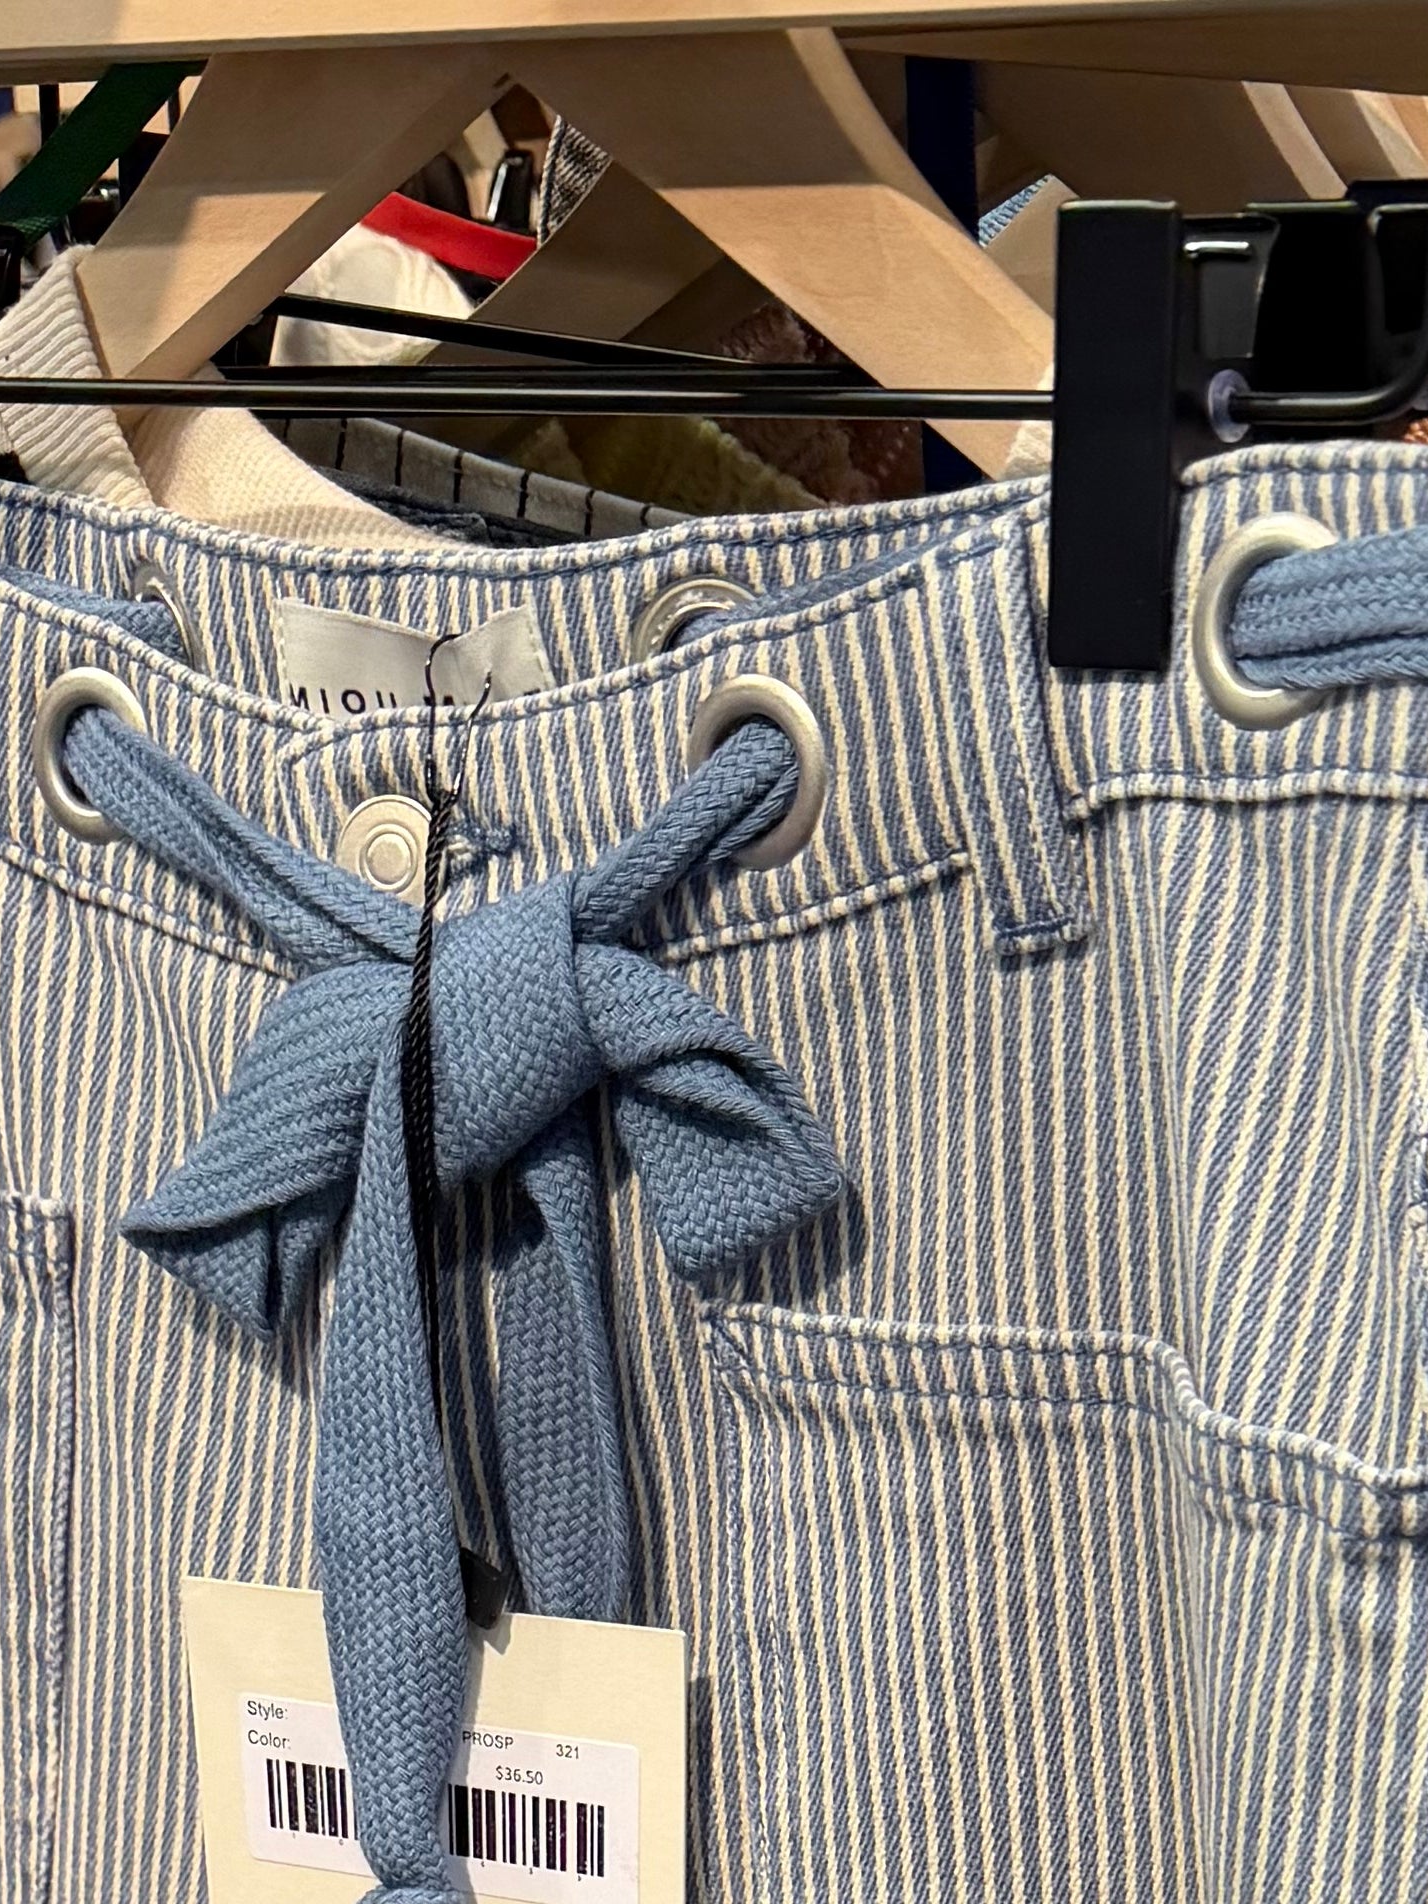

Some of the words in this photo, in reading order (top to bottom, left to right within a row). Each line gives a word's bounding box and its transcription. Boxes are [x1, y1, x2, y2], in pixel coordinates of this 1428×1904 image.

[247, 1700, 289, 1721] Style:
[247, 1729, 291, 1750] Color:
[462, 1730, 514, 1750] PROSP
[555, 1744, 580, 1759] 321
[495, 1765, 544, 1785] $36.50
